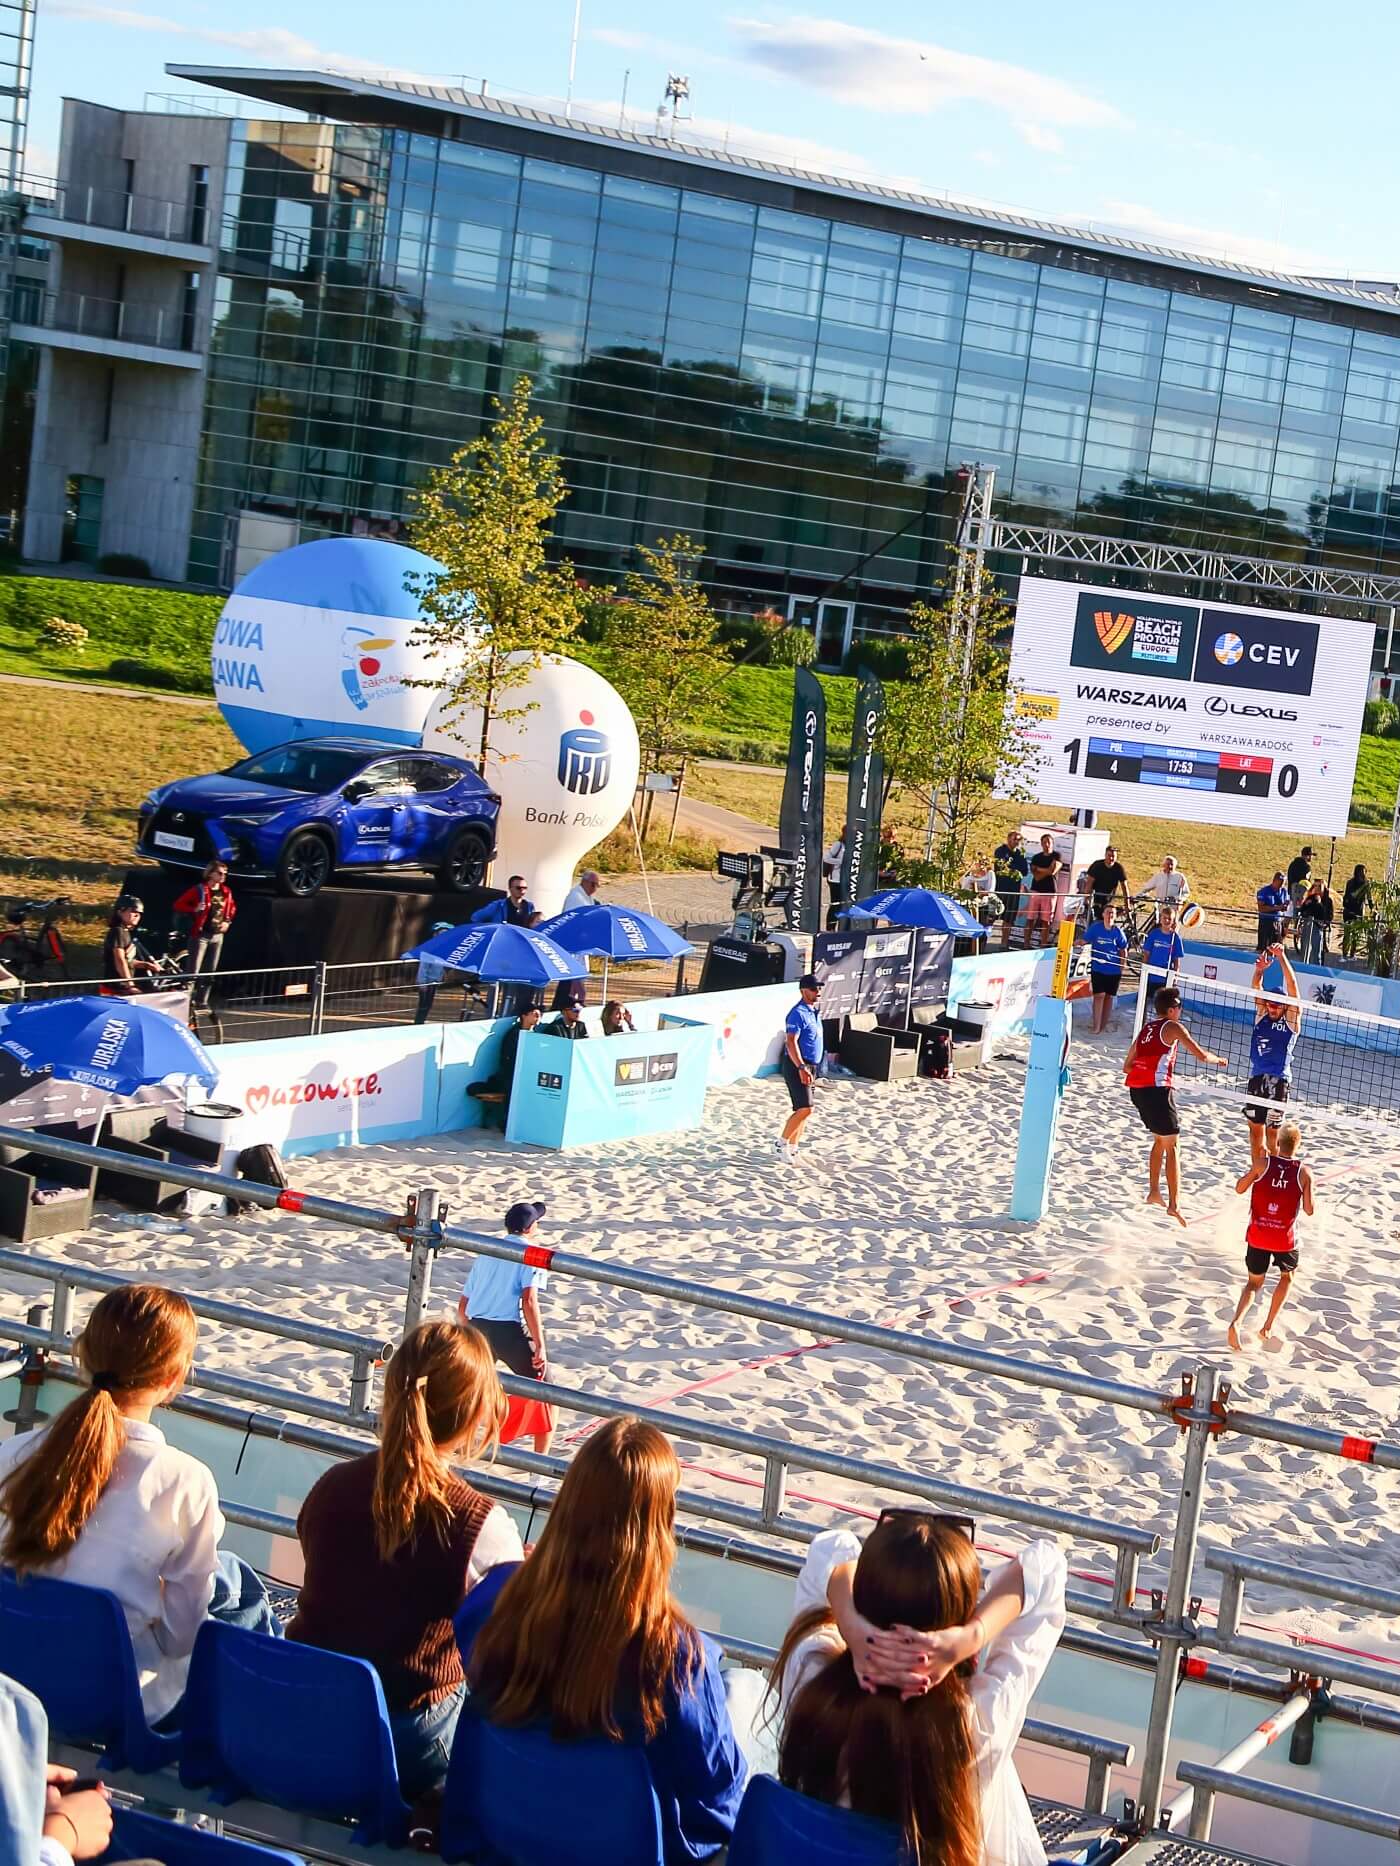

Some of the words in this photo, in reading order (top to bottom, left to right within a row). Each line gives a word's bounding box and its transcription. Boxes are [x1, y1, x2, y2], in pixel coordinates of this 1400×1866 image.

[1135, 620, 1181, 637] BEACH
[1133, 631, 1154, 643] PRO
[1154, 634, 1180, 646] TOUR
[1141, 644, 1170, 654] EUROPE
[1248, 642, 1301, 668] CEV
[1077, 684, 1187, 712] WARSZAWA
[1231, 703, 1298, 722] LEXUS
[1086, 713, 1152, 732] presented
[1155, 720, 1172, 735] by
[1109, 741, 1125, 753] POL
[1200, 731, 1253, 747] WARSZAWA
[1063, 738, 1081, 774] 1
[1239, 758, 1253, 768] LAT
[1110, 759, 1119, 774] 4
[1168, 759, 1194, 774] 17:53
[1239, 774, 1247, 788] 4
[1277, 763, 1299, 798] 0
[526, 806, 568, 825] Bank
[618, 917, 648, 953] JURAJSKA
[448, 930, 486, 967] JURAJSKA
[712, 945, 749, 959] GENERAC
[90, 1018, 129, 1070] JURAJSKA
[72, 1071, 119, 1091] JURAJSKA
[1280, 1169, 1285, 1179] 1
[1271, 1178, 1288, 1189] LAT
